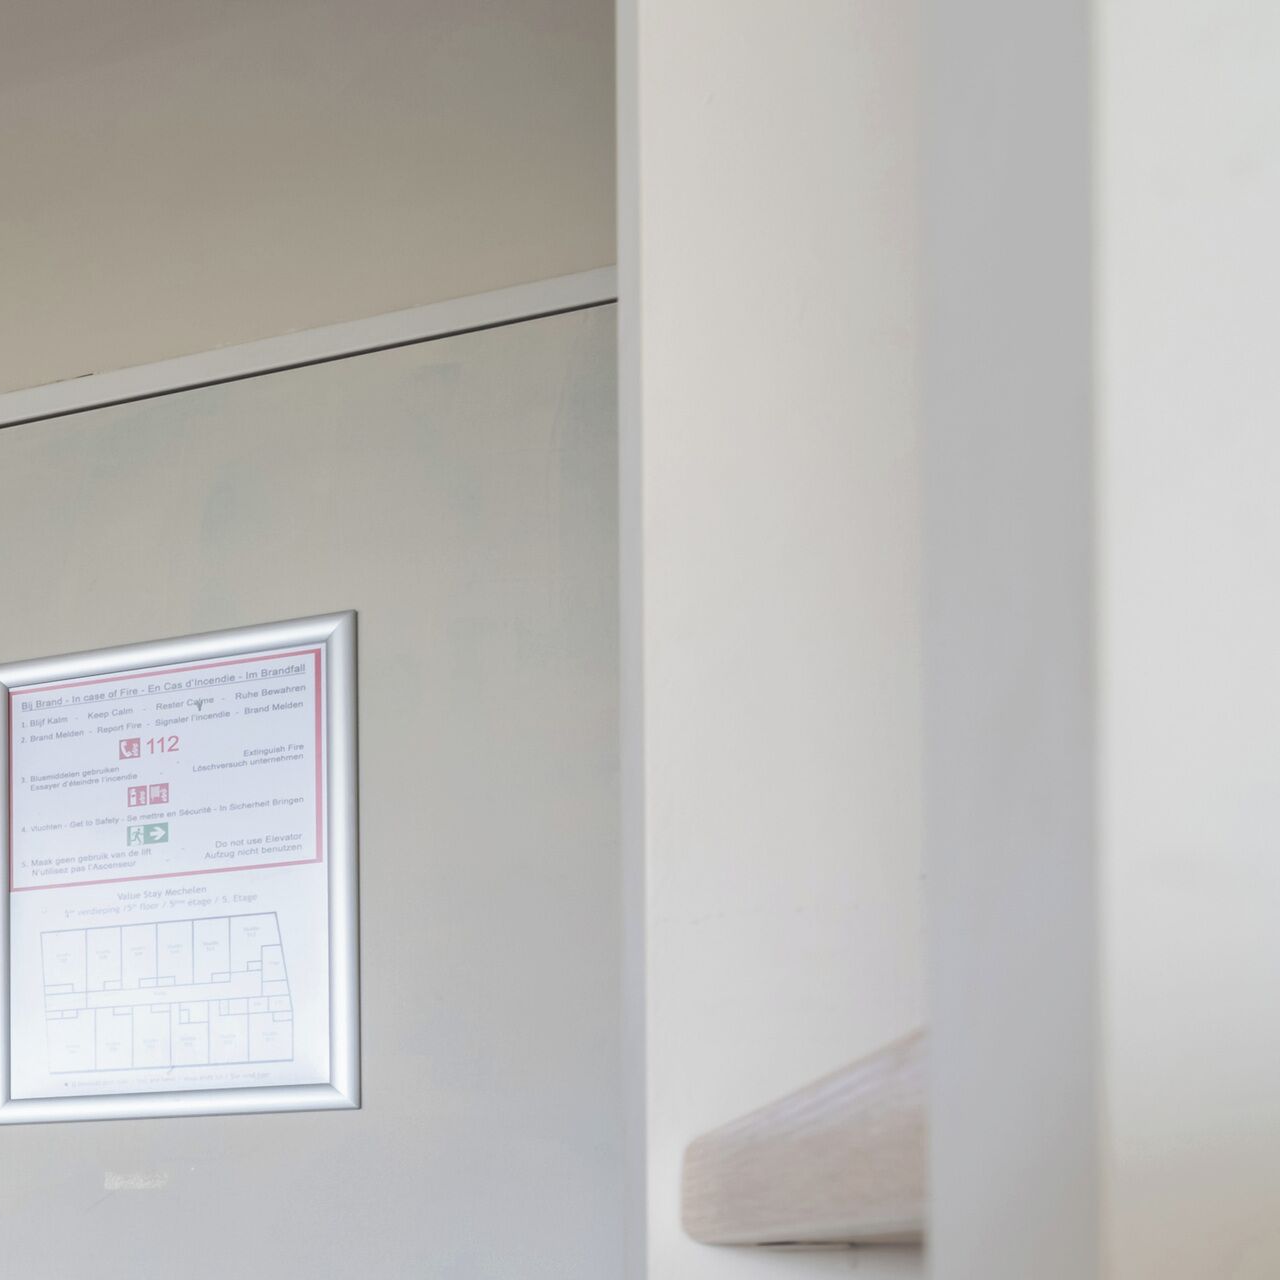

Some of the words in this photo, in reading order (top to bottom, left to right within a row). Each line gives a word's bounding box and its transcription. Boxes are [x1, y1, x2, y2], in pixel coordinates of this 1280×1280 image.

[21, 702, 33, 711] Bij
[35, 697, 63, 709] Brand
[71, 695, 81, 704] In
[83, 693, 106, 702] case
[107, 689, 118, 699] of
[120, 687, 139, 697] Fire
[147, 684, 161, 694] En
[163, 682, 183, 691] Cas
[185, 674, 236, 688] d'Incendie
[245, 671, 258, 680] Im
[260, 664, 306, 678] Brandfall
[29, 718, 45, 728] Blijf
[47, 716, 68, 725] Kalm
[87, 710, 110, 720] Keep
[111, 706, 134, 717] Calm
[155, 700, 184, 711] Rester
[234, 691, 259, 700] Ruhe
[261, 684, 306, 696] Bewahren
[29, 732, 54, 743] Brand
[55, 729, 85, 740] Melden
[96, 725, 124, 735] Report
[126, 722, 142, 731] Fire
[154, 716, 189, 727] Signaler
[243, 706, 270, 715] Brand
[271, 701, 304, 711] Melden
[146, 735, 180, 754] 112
[243, 745, 286, 757] Extinguish
[287, 744, 305, 752] Fire
[82, 766, 120, 778] gebruiken
[30, 782, 60, 792] Essayer
[69, 820, 84, 829] Get
[85, 819, 93, 827] to
[127, 814, 138, 822] Se
[166, 810, 176, 818] en
[219, 804, 227, 812] In
[271, 797, 305, 807] Bringen
[215, 840, 228, 848] Do
[230, 838, 245, 847] not
[246, 837, 263, 845] use
[265, 832, 303, 843] Elevator
[78, 852, 109, 863] gebruik
[110, 851, 126, 859] van
[128, 849, 139, 857] de
[141, 848, 152, 856] lift
[237, 846, 259, 856] nicht
[261, 843, 303, 854] benutzen
[70, 865, 86, 873] pas
[117, 891, 142, 901] Value
[143, 890, 163, 899] Stay
[164, 885, 208, 897] Mechelen
